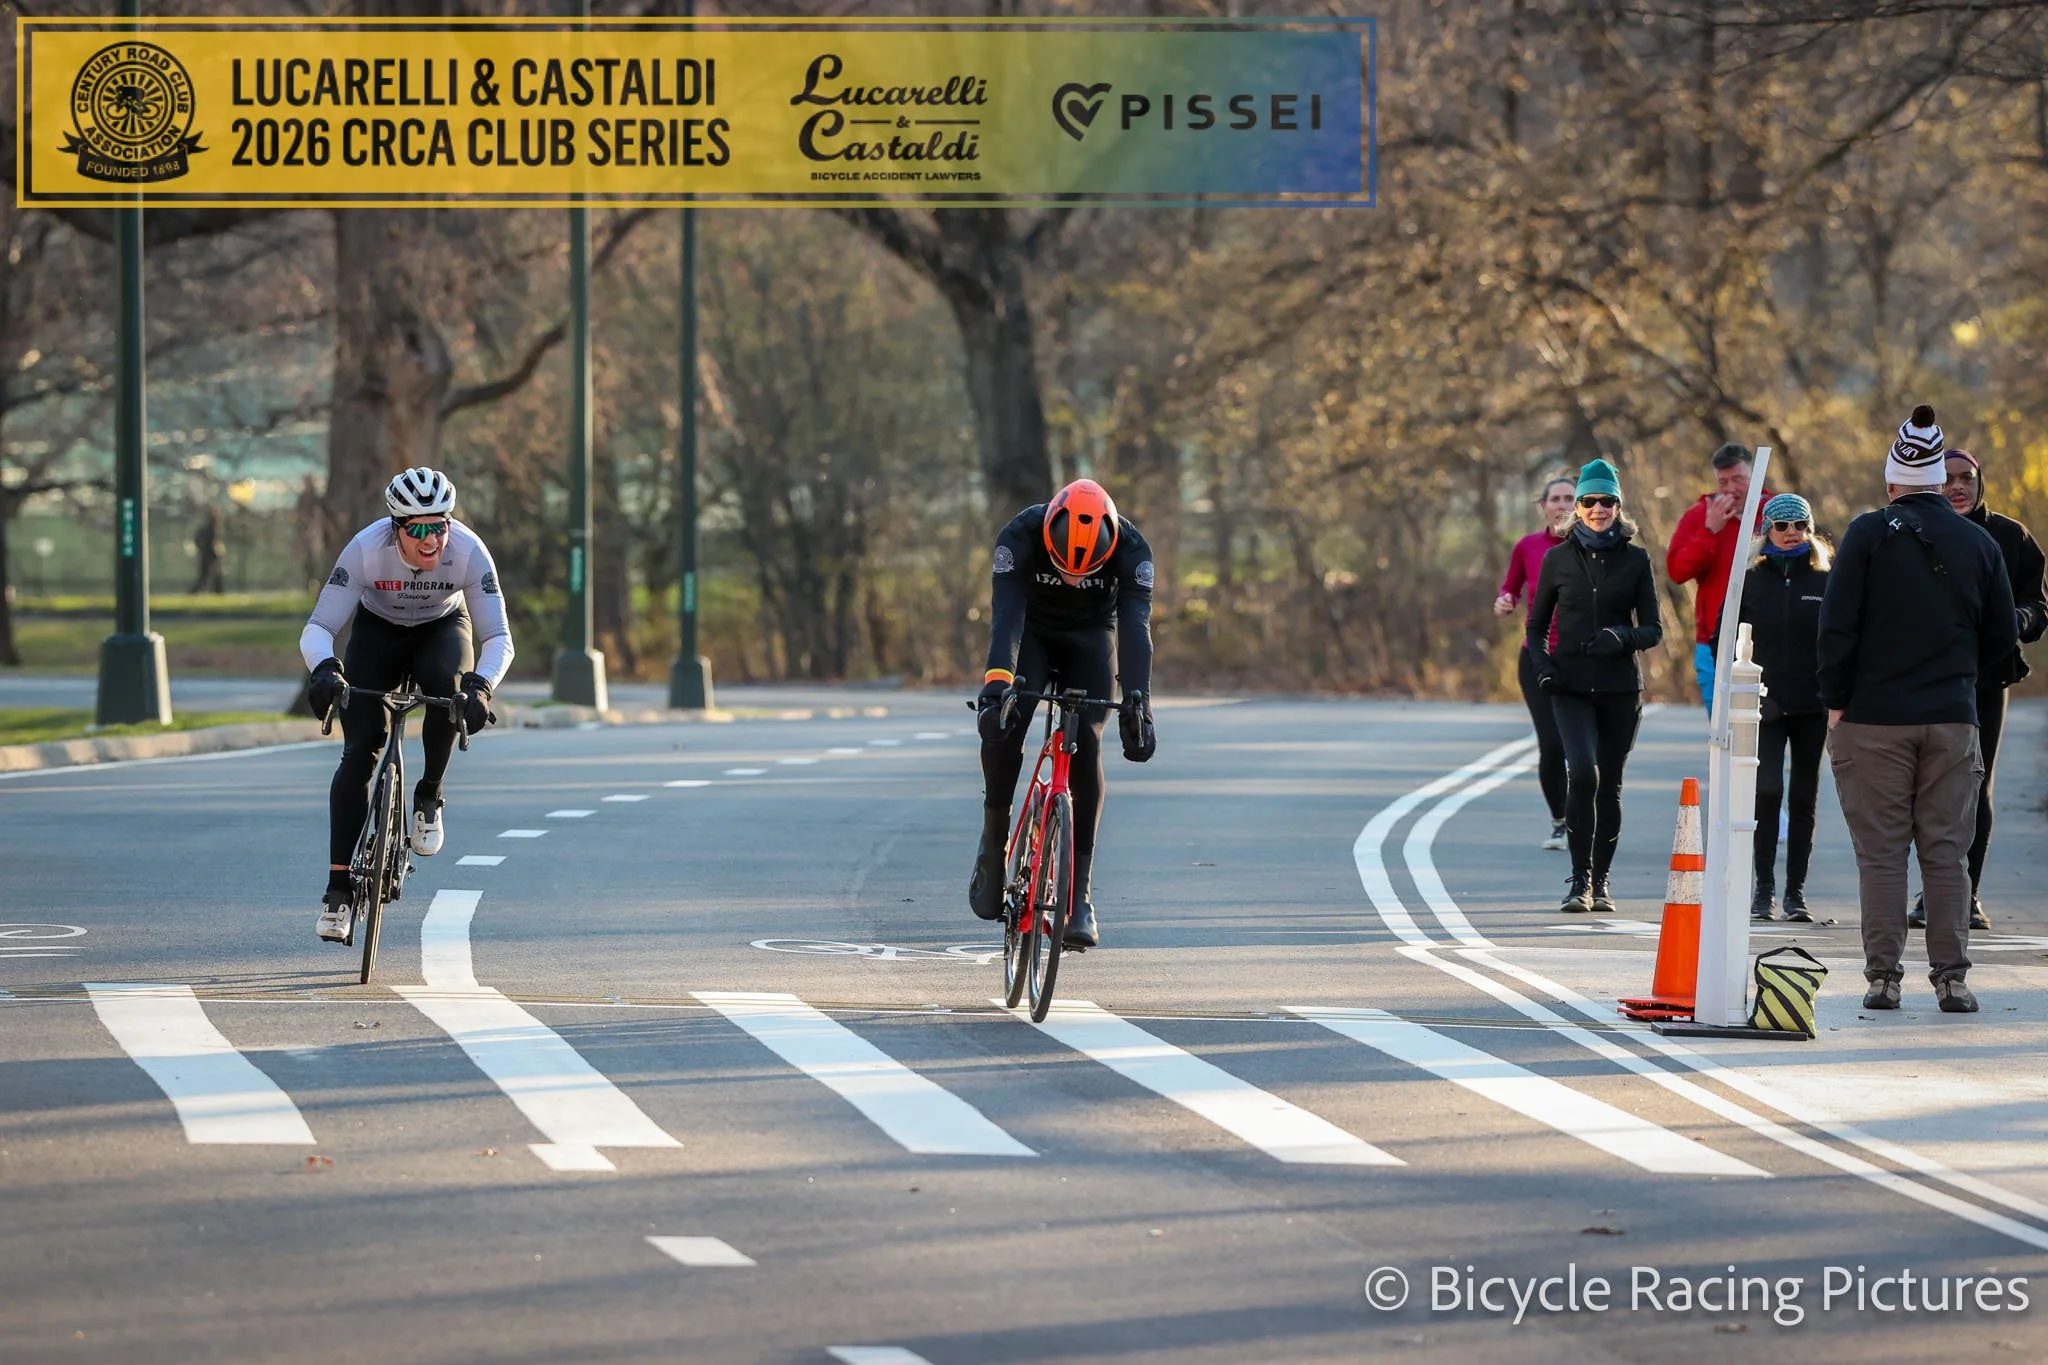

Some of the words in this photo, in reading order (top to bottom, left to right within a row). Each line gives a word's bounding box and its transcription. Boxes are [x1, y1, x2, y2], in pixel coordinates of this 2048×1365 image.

[377, 581, 400, 590] THE
[403, 581, 454, 590] PROGRAM
[397, 592, 431, 600] Racing
